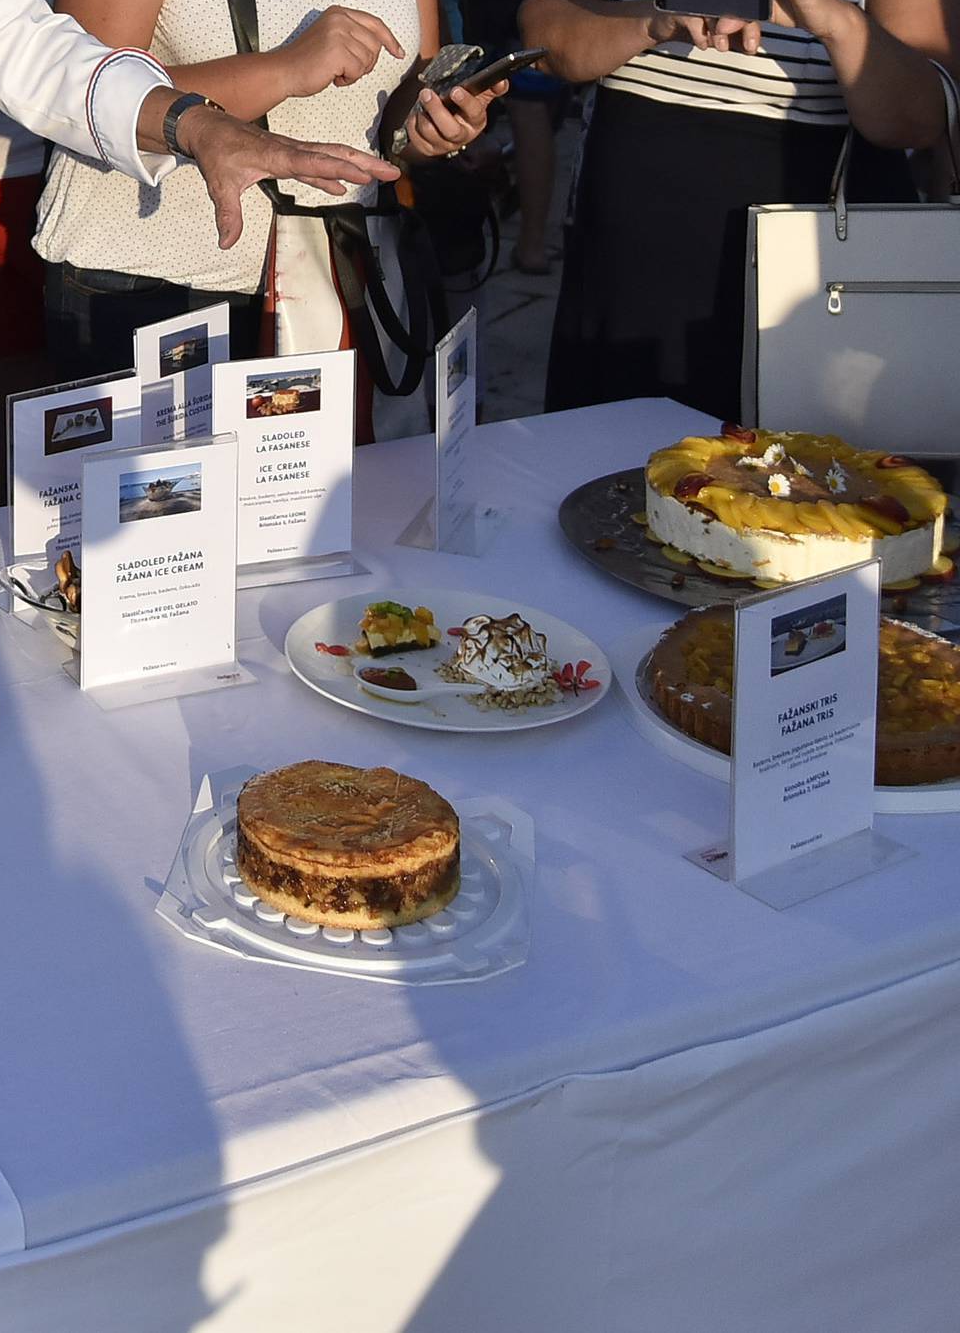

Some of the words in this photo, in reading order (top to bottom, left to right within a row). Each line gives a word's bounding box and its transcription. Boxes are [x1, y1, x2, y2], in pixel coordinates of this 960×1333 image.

[262, 431, 306, 443] SLADOLED
[256, 445, 267, 454] LA
[269, 441, 311, 452] FASANESE
[260, 465, 273, 473] ICE
[277, 461, 307, 471] CREAM
[256, 475, 267, 484] LA
[268, 471, 311, 483] FASANESE
[40, 482, 80, 499] FAŽANSKA
[44, 496, 74, 508] FAŽANA
[117, 557, 166, 572] SLADOLED
[168, 550, 204, 564] FAŽANA
[116, 570, 153, 584] FAŽANA
[155, 568, 169, 577] ICE
[172, 562, 205, 575] CREAM
[778, 702, 819, 724] FAŽANSKI
[820, 692, 839, 708] TRIS
[781, 714, 815, 737] FAŽANA
[816, 708, 835, 723] TRIS
